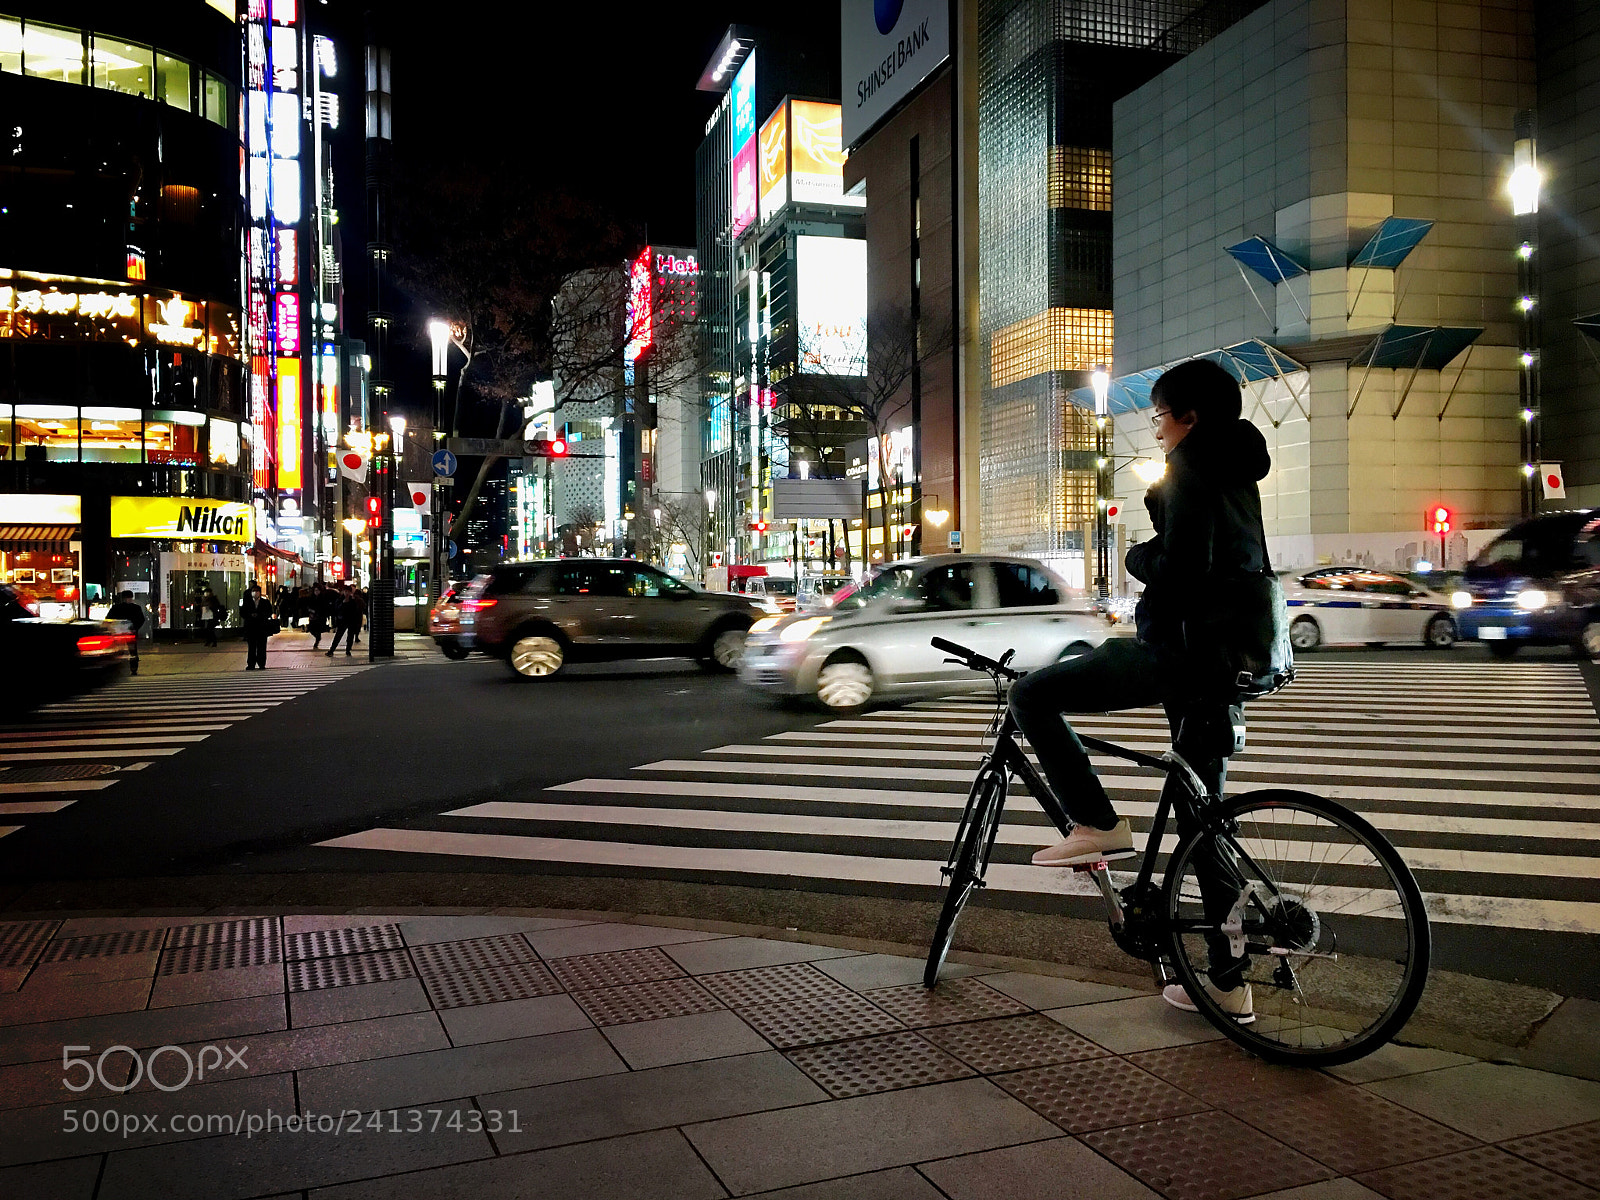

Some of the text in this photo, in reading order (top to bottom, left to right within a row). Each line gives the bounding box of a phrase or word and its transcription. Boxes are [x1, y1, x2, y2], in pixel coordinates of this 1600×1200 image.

[857, 16, 929, 108] SHINSEI BANK
[176, 505, 244, 535] Nikon
